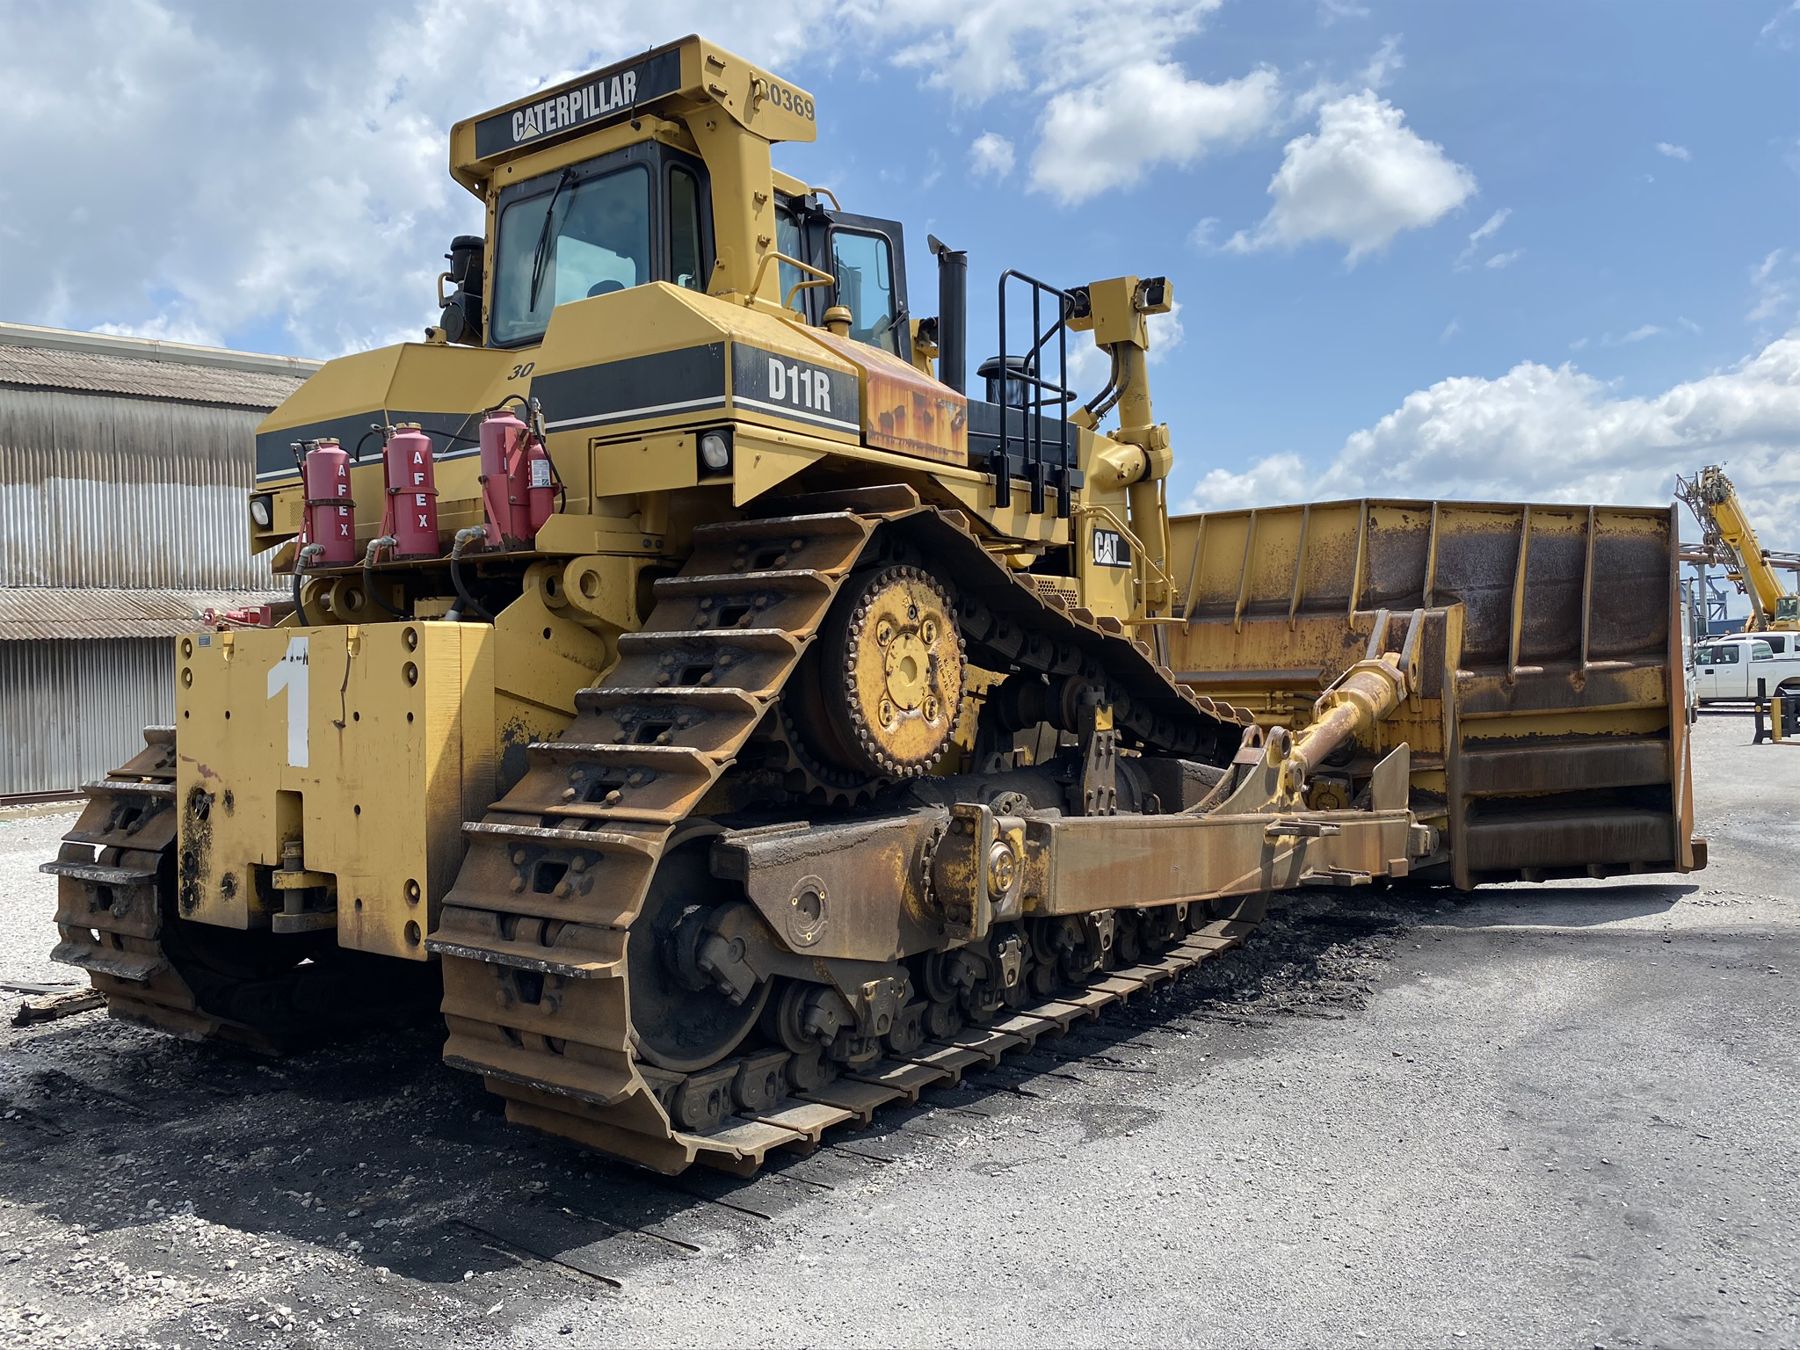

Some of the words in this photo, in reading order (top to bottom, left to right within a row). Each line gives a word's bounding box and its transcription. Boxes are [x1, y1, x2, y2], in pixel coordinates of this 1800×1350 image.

[512, 70, 637, 142] CATERPILLAR
[768, 357, 830, 412] D11R
[337, 464, 349, 536] AFEX
[412, 451, 428, 528] AFEX
[1095, 531, 1119, 564] CAT
[267, 636, 309, 768] 1
